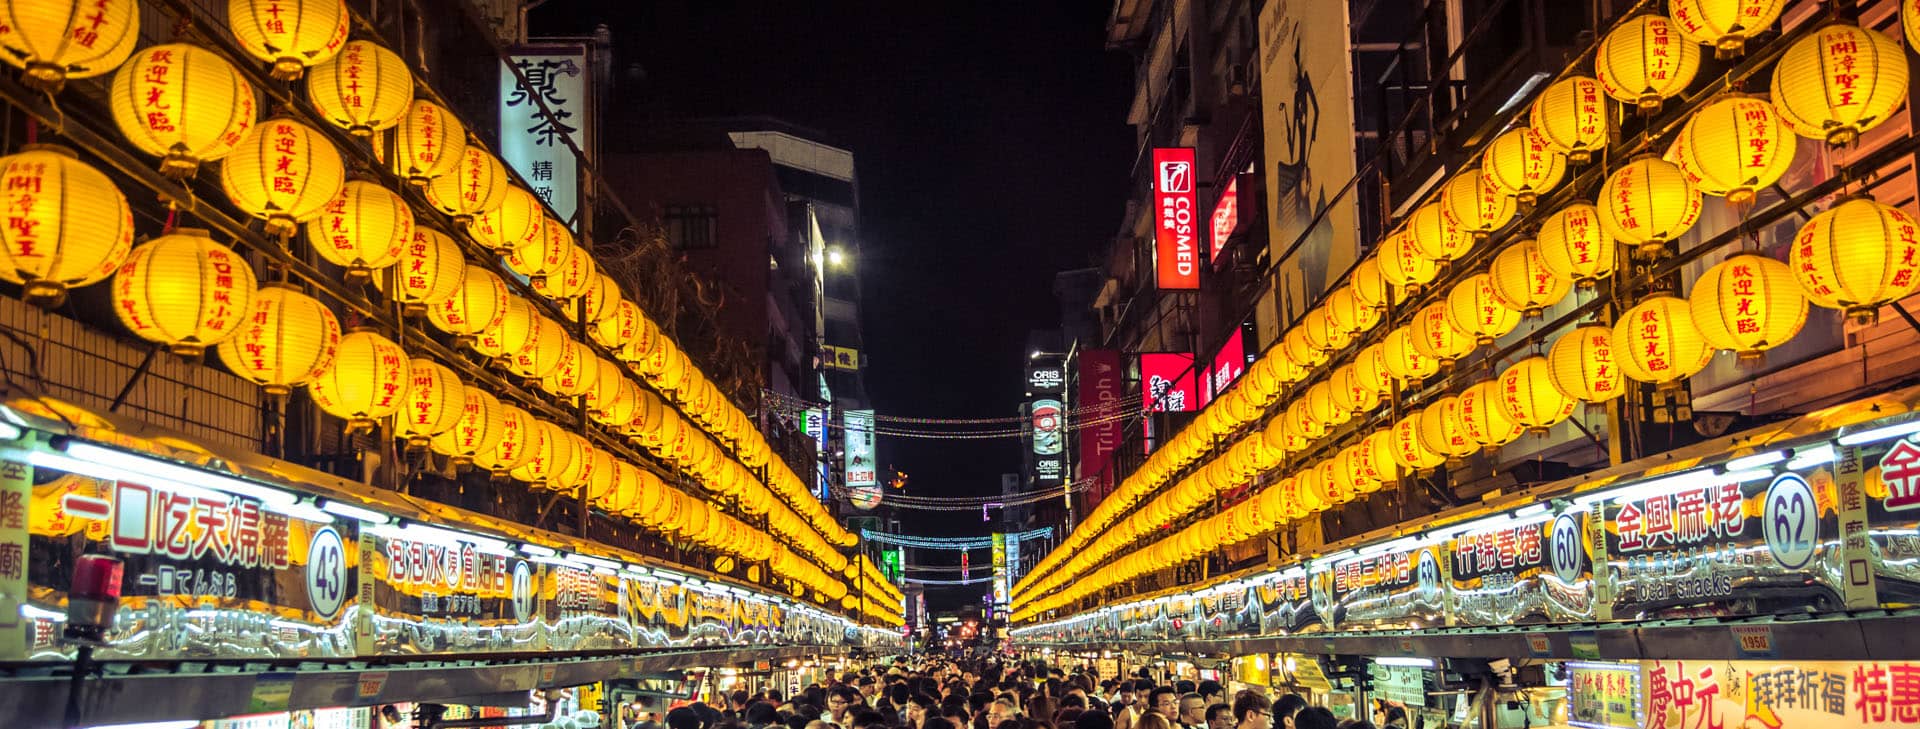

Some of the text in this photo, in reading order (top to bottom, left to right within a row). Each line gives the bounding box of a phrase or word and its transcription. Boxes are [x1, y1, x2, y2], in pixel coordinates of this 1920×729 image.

[1648, 19, 1668, 81] 廟口攤販小組
[1830, 41, 1859, 107] 開漳聖王
[145, 50, 175, 133] 歡迎光臨
[274, 124, 297, 194] 歡迎光臨
[1745, 110, 1767, 168] 開漳聖王
[7, 176, 45, 258] 開漳聖王
[1176, 197, 1191, 276] COSMED
[1570, 217, 1592, 264] 開漳聖王
[1800, 221, 1833, 296] 廟口攤販小組
[1732, 265, 1760, 334] 歡迎光臨
[1592, 336, 1612, 392] 歡迎光臨
[1640, 310, 1669, 371] 歡迎光臨
[1033, 370, 1059, 379] ORIS
[1096, 378, 1116, 456] Triumph
[63, 480, 290, 570] 一口吃天婦羅
[1457, 523, 1542, 575] 什錦春捲
[1556, 527, 1577, 570] 60
[1773, 492, 1810, 554] 62
[316, 546, 339, 600] 43
[1335, 552, 1410, 592] 營養三明治
[1421, 557, 1433, 584] 58
[1635, 571, 1732, 602] local snacks
[1742, 635, 1767, 649] 1950
[1752, 668, 1849, 717] 拜拜祈福
[1853, 662, 1920, 725] 特惠
